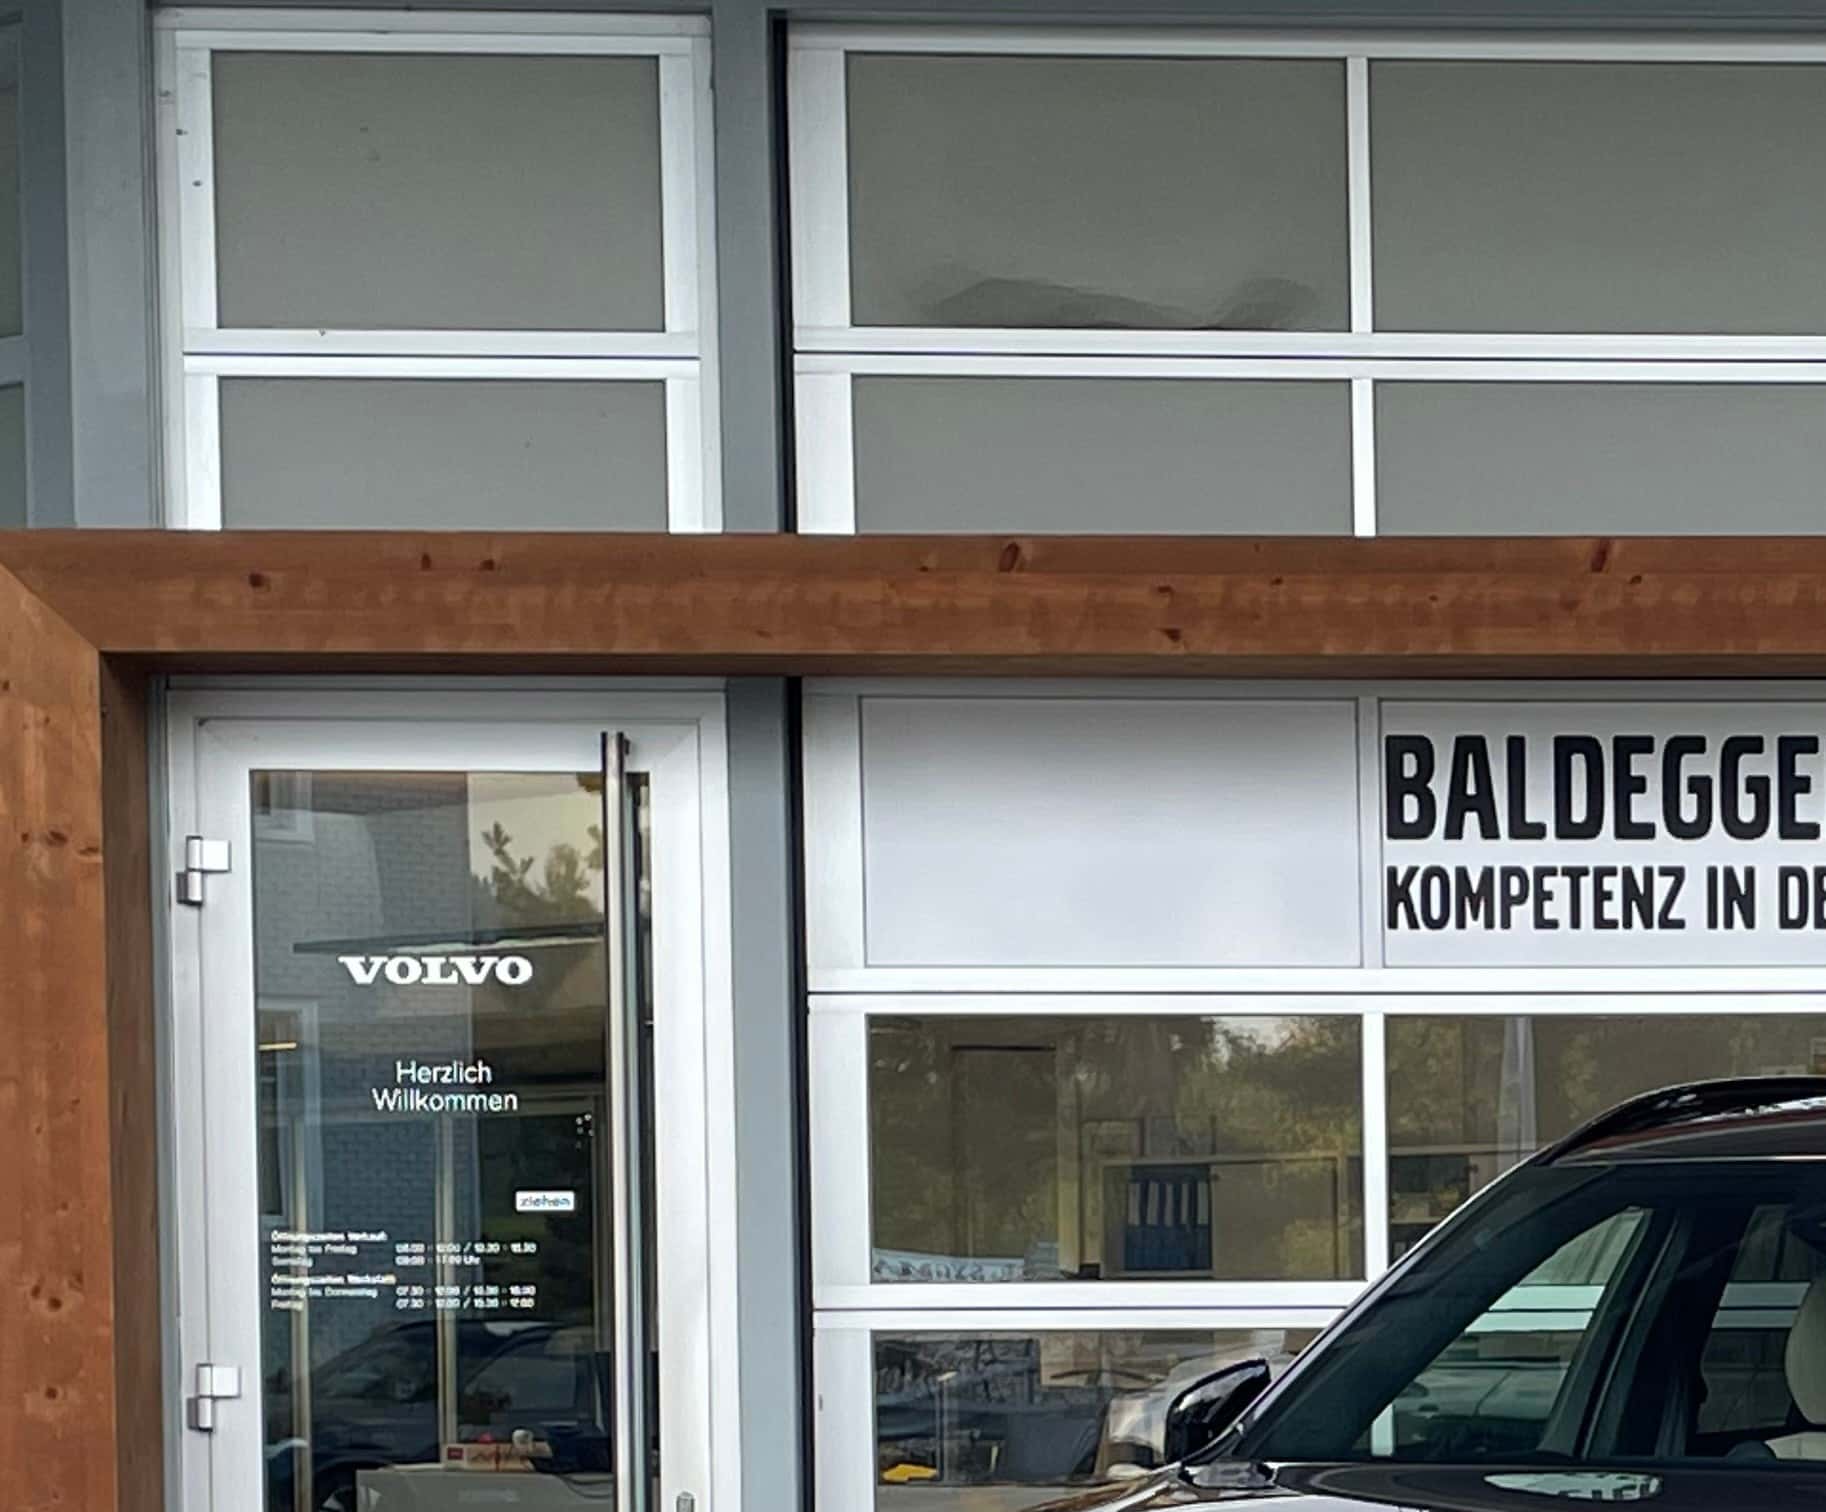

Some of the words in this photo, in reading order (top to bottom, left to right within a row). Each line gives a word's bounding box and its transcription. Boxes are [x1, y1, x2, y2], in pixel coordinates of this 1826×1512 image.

[1386, 866, 1686, 930] KOMPETENZ
[1707, 866, 1756, 930] IN
[338, 956, 533, 985] VOLVO
[396, 1060, 492, 1084] Herzlich
[371, 1087, 519, 1112] Willkommen
